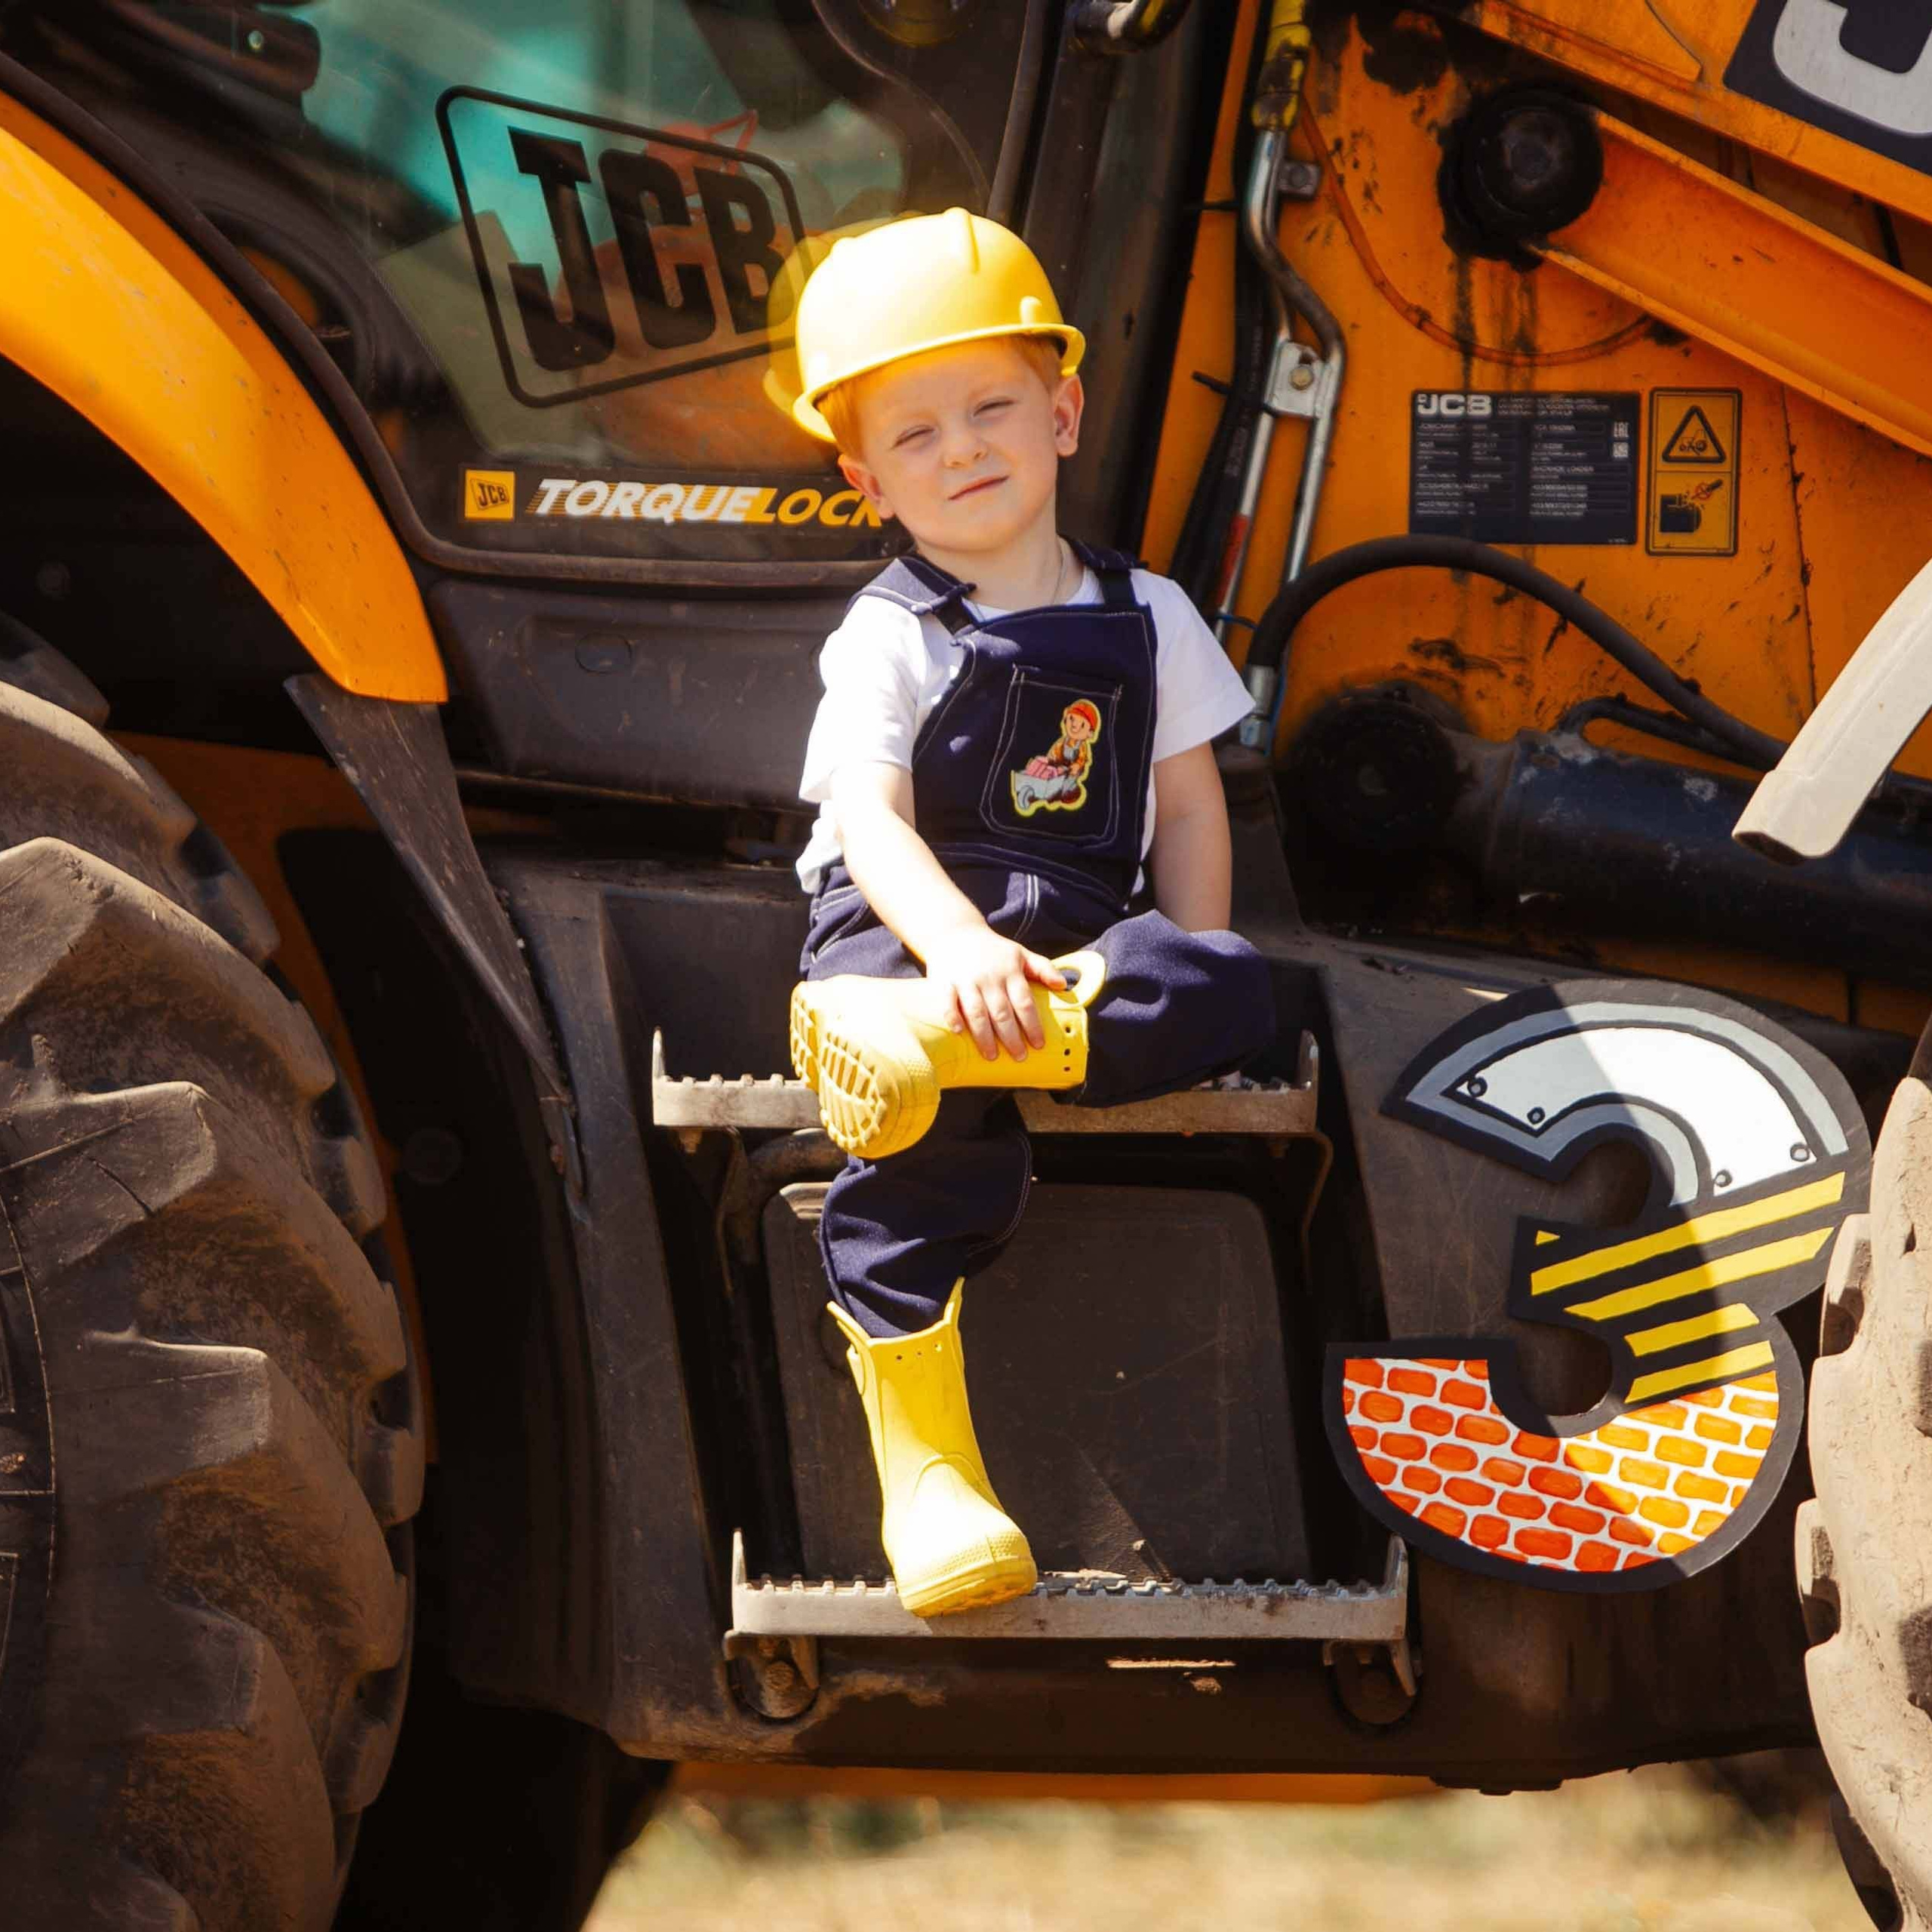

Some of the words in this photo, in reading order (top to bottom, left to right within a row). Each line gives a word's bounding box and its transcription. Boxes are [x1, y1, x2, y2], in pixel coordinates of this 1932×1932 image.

[507, 125, 795, 371] JCB
[1417, 394, 1492, 417] JCB
[478, 483, 507, 506] JCB
[1324, 978, 1872, 1592] 3
